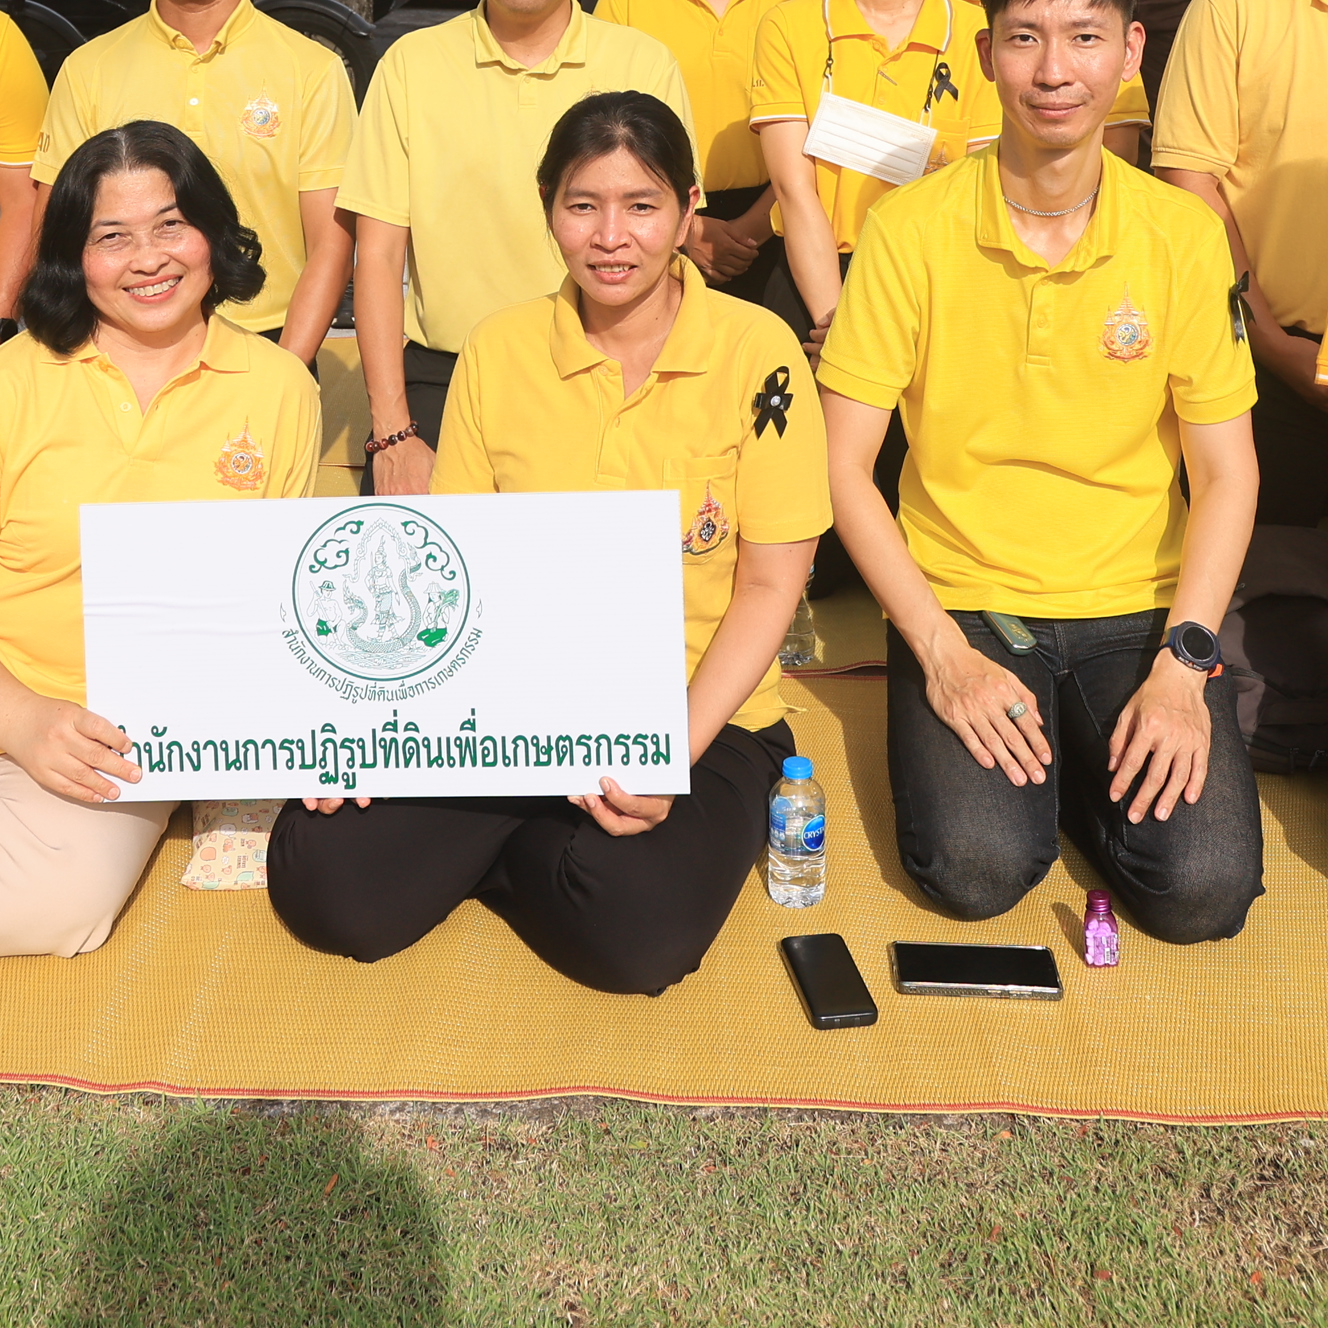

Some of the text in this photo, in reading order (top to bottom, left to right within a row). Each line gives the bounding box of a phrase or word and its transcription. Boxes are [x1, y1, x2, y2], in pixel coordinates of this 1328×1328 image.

[117, 708, 671, 790] ำนักงานการปฏิรูปที่ดินเพื่อเกษตรกรรม
